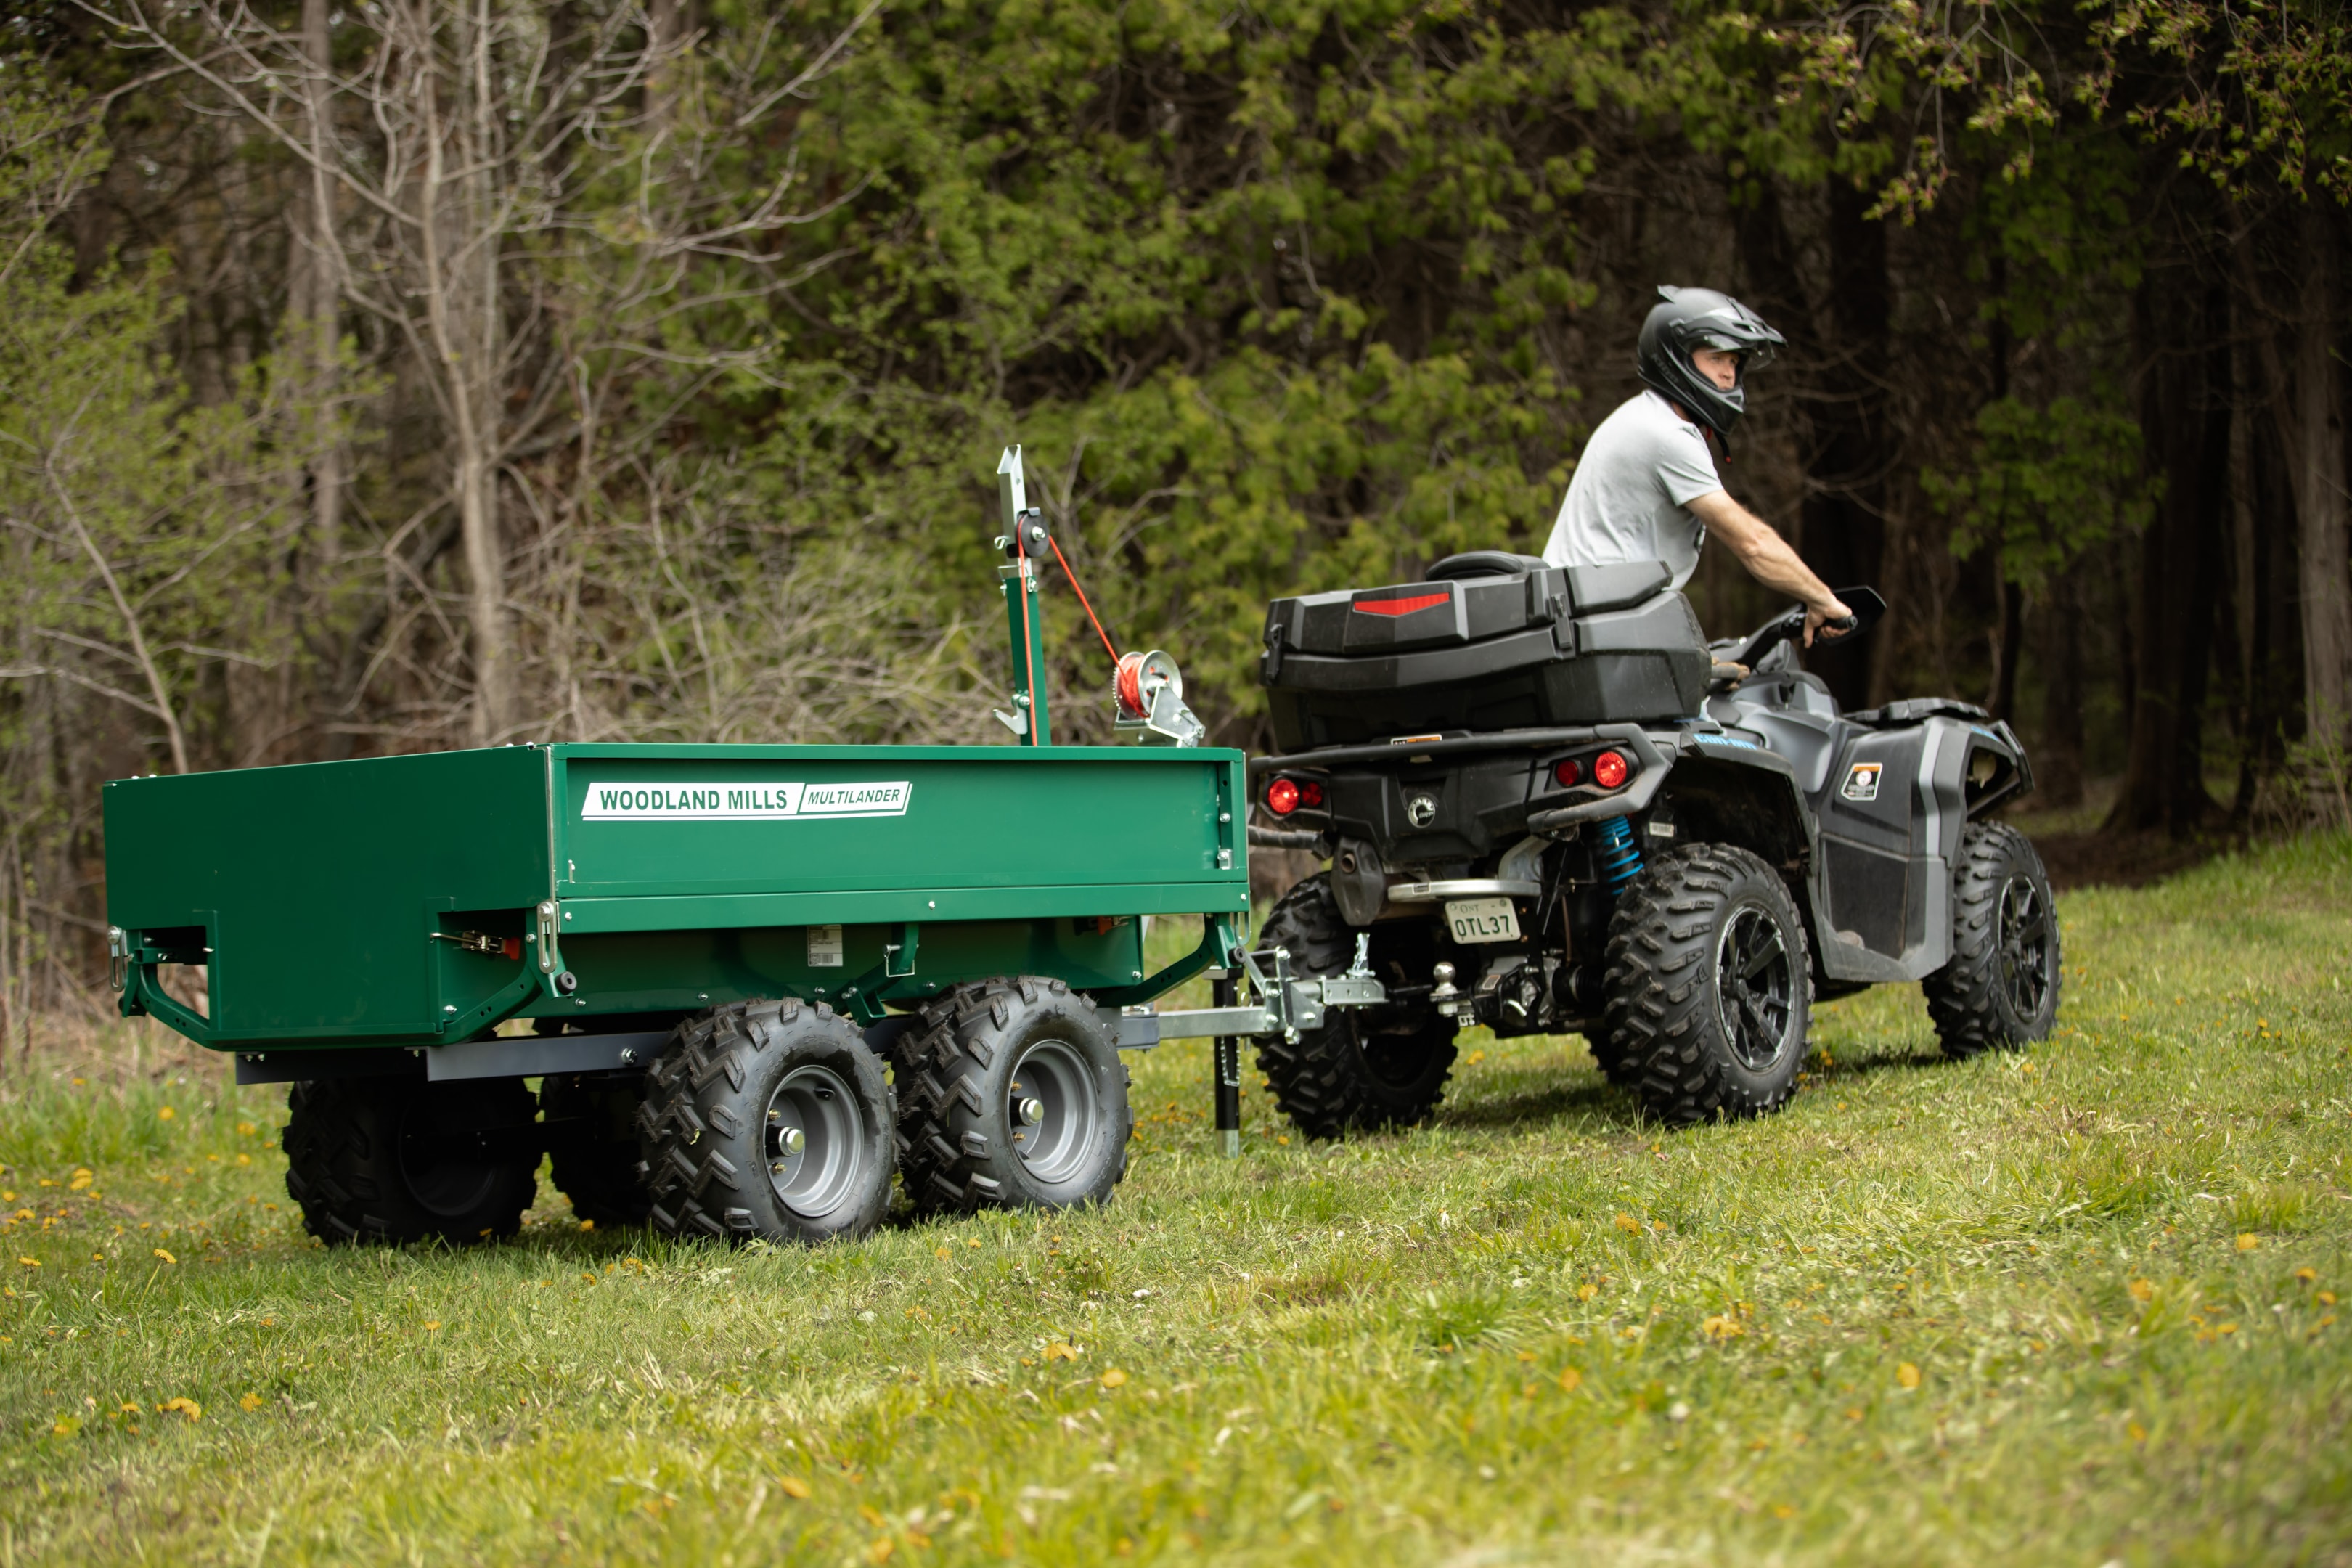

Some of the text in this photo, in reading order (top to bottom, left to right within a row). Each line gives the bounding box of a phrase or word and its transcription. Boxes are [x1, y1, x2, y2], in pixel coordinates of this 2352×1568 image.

[600, 789, 788, 811] WOODLAND MILLS
[807, 788, 900, 806] MULTILANDER
